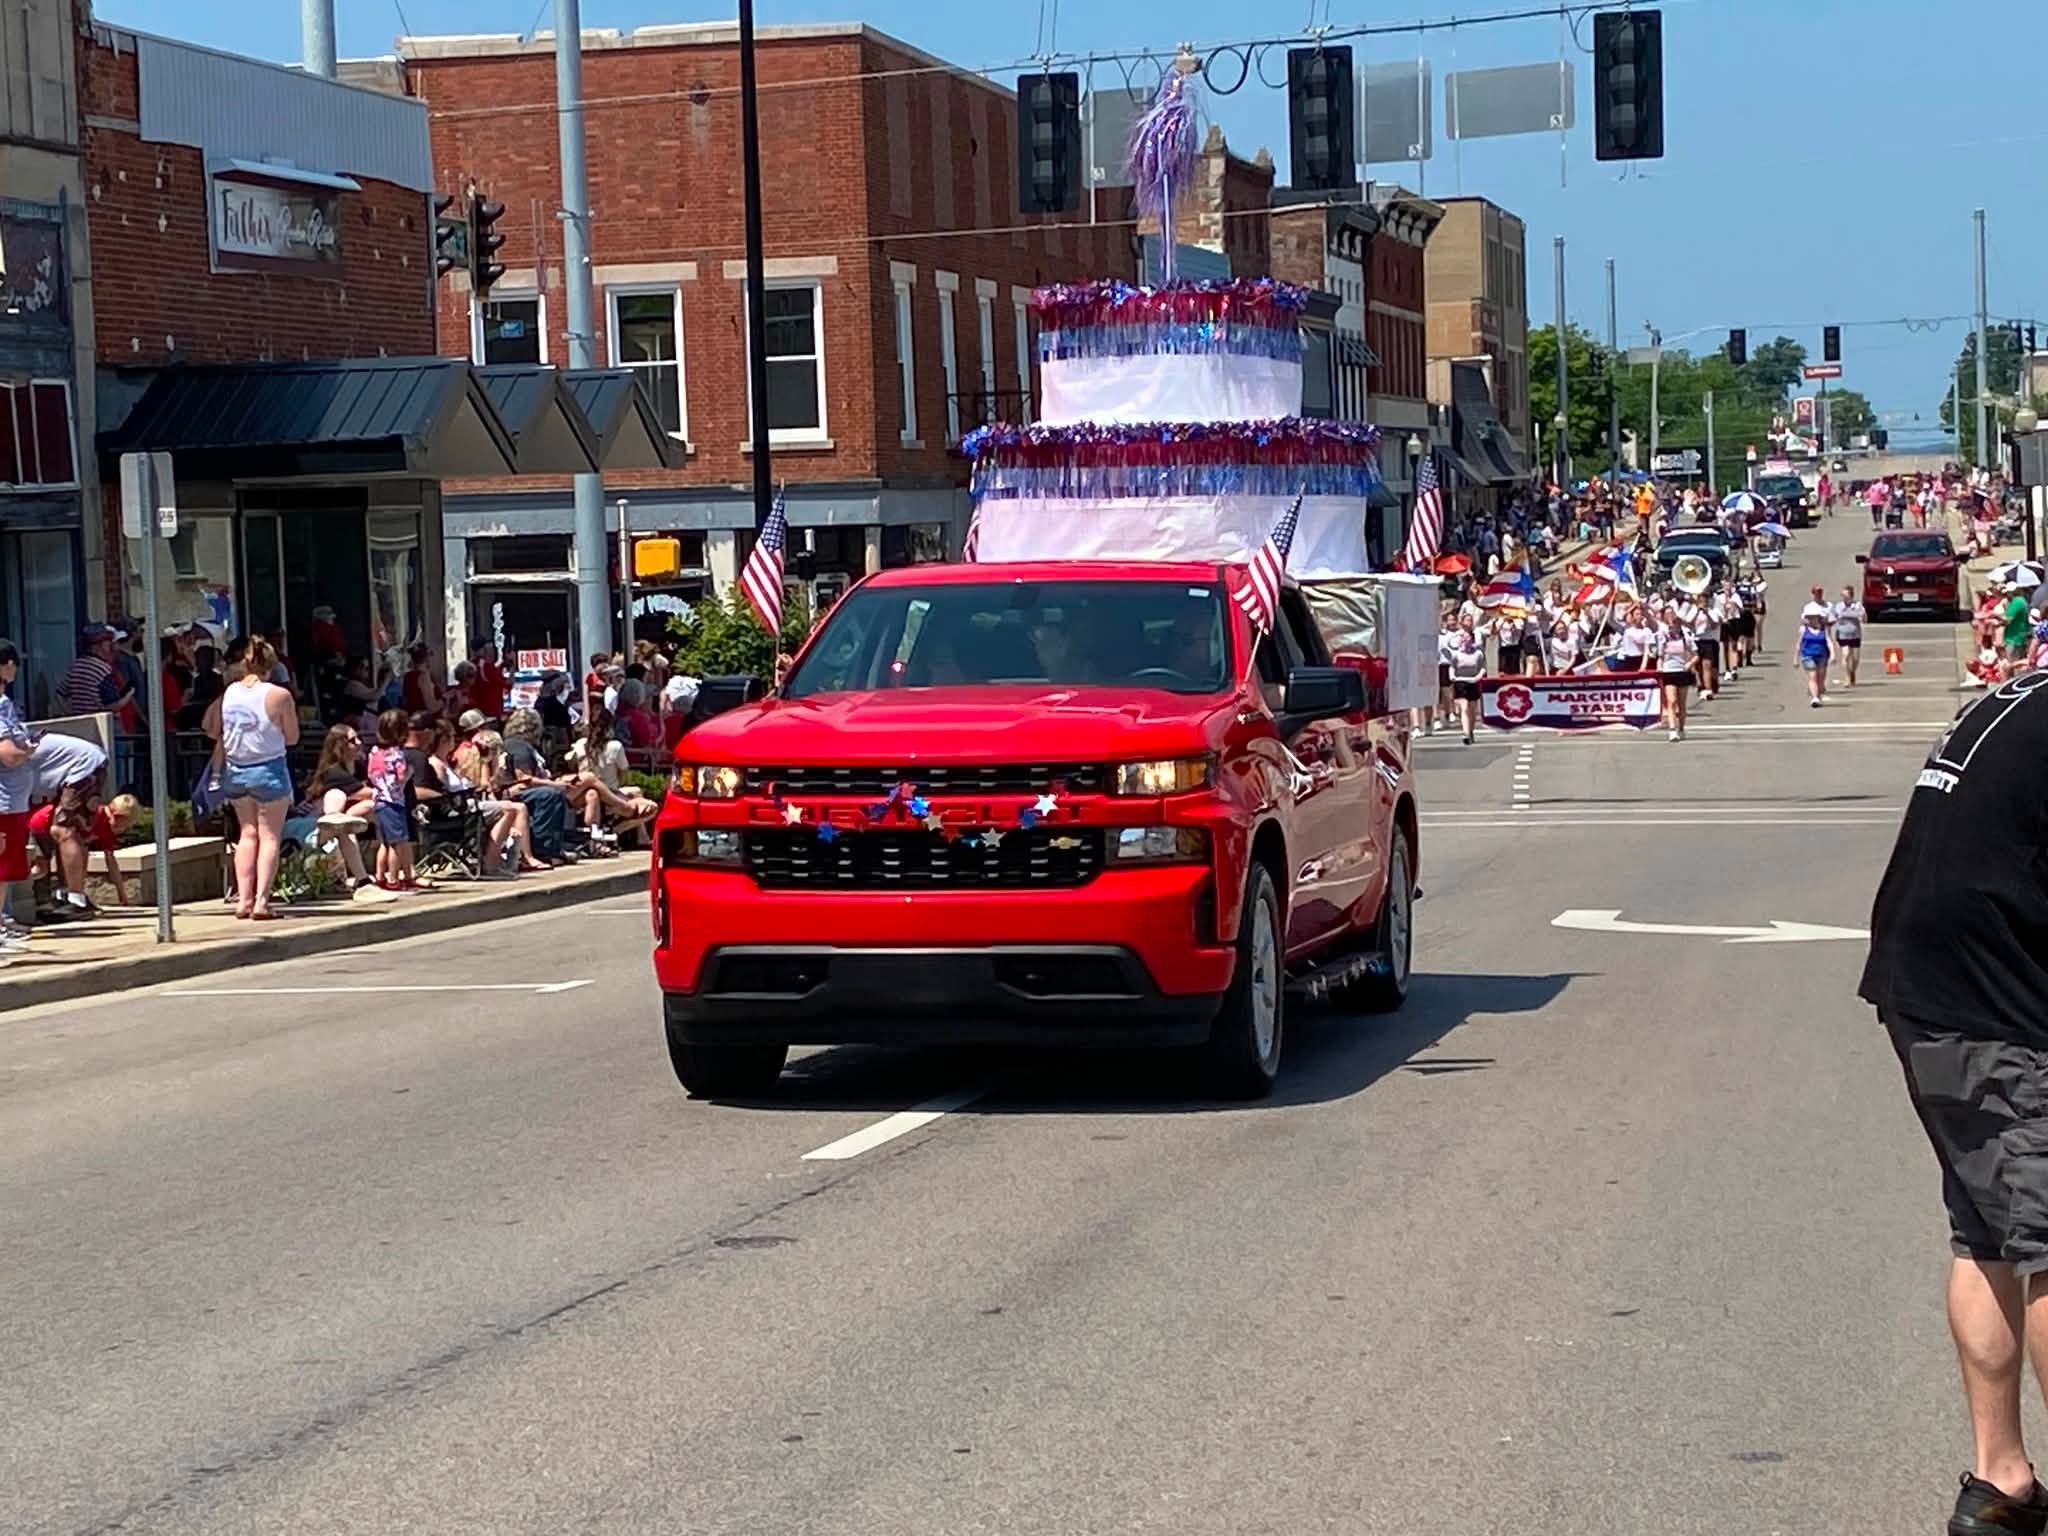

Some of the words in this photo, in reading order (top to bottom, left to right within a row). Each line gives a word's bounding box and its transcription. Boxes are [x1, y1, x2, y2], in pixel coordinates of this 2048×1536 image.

[520, 651, 539, 668] FOR
[542, 650, 564, 667] SALE
[1547, 691, 1646, 703] MARCHING
[1569, 703, 1627, 714] STARS
